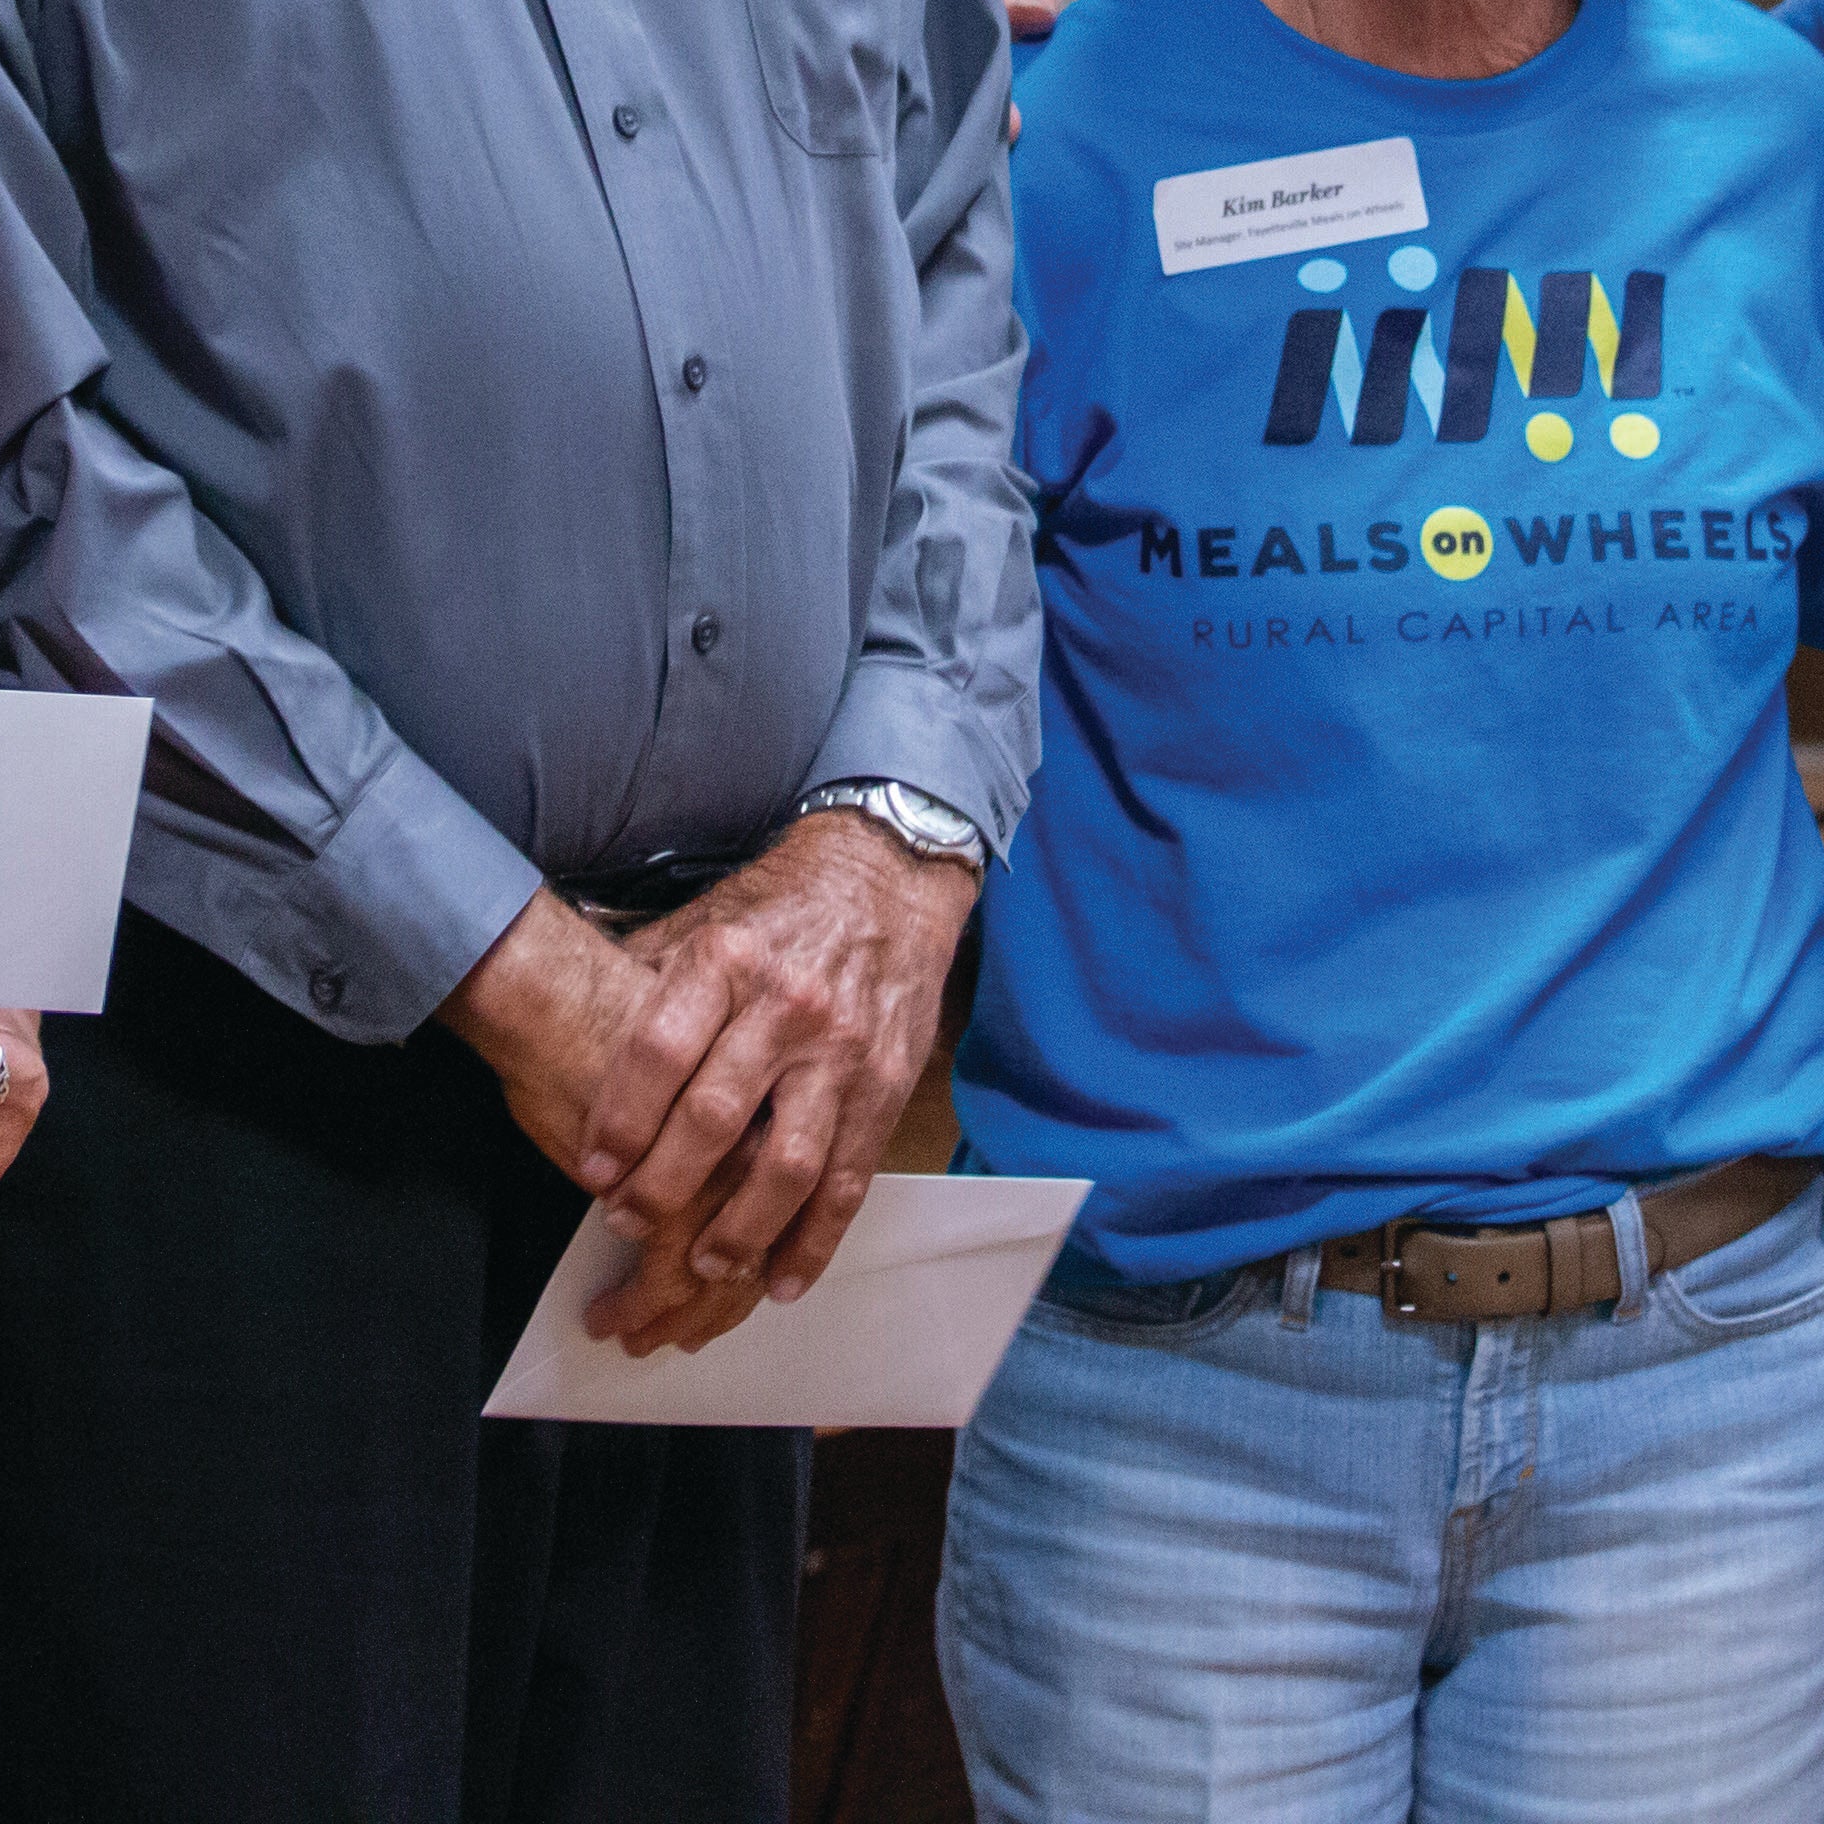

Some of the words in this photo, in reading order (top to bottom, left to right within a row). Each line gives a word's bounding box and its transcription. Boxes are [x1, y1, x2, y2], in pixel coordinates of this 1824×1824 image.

[1221, 194, 1265, 218] Kim
[1271, 182, 1344, 210] Barker
[1139, 521, 1411, 578] MEALS
[1432, 530, 1485, 556] on
[1504, 511, 1793, 566] WHEELS
[1192, 614, 1366, 651] RURAL
[1397, 603, 1625, 644] CAPITAL
[1655, 600, 1759, 633] AREA
